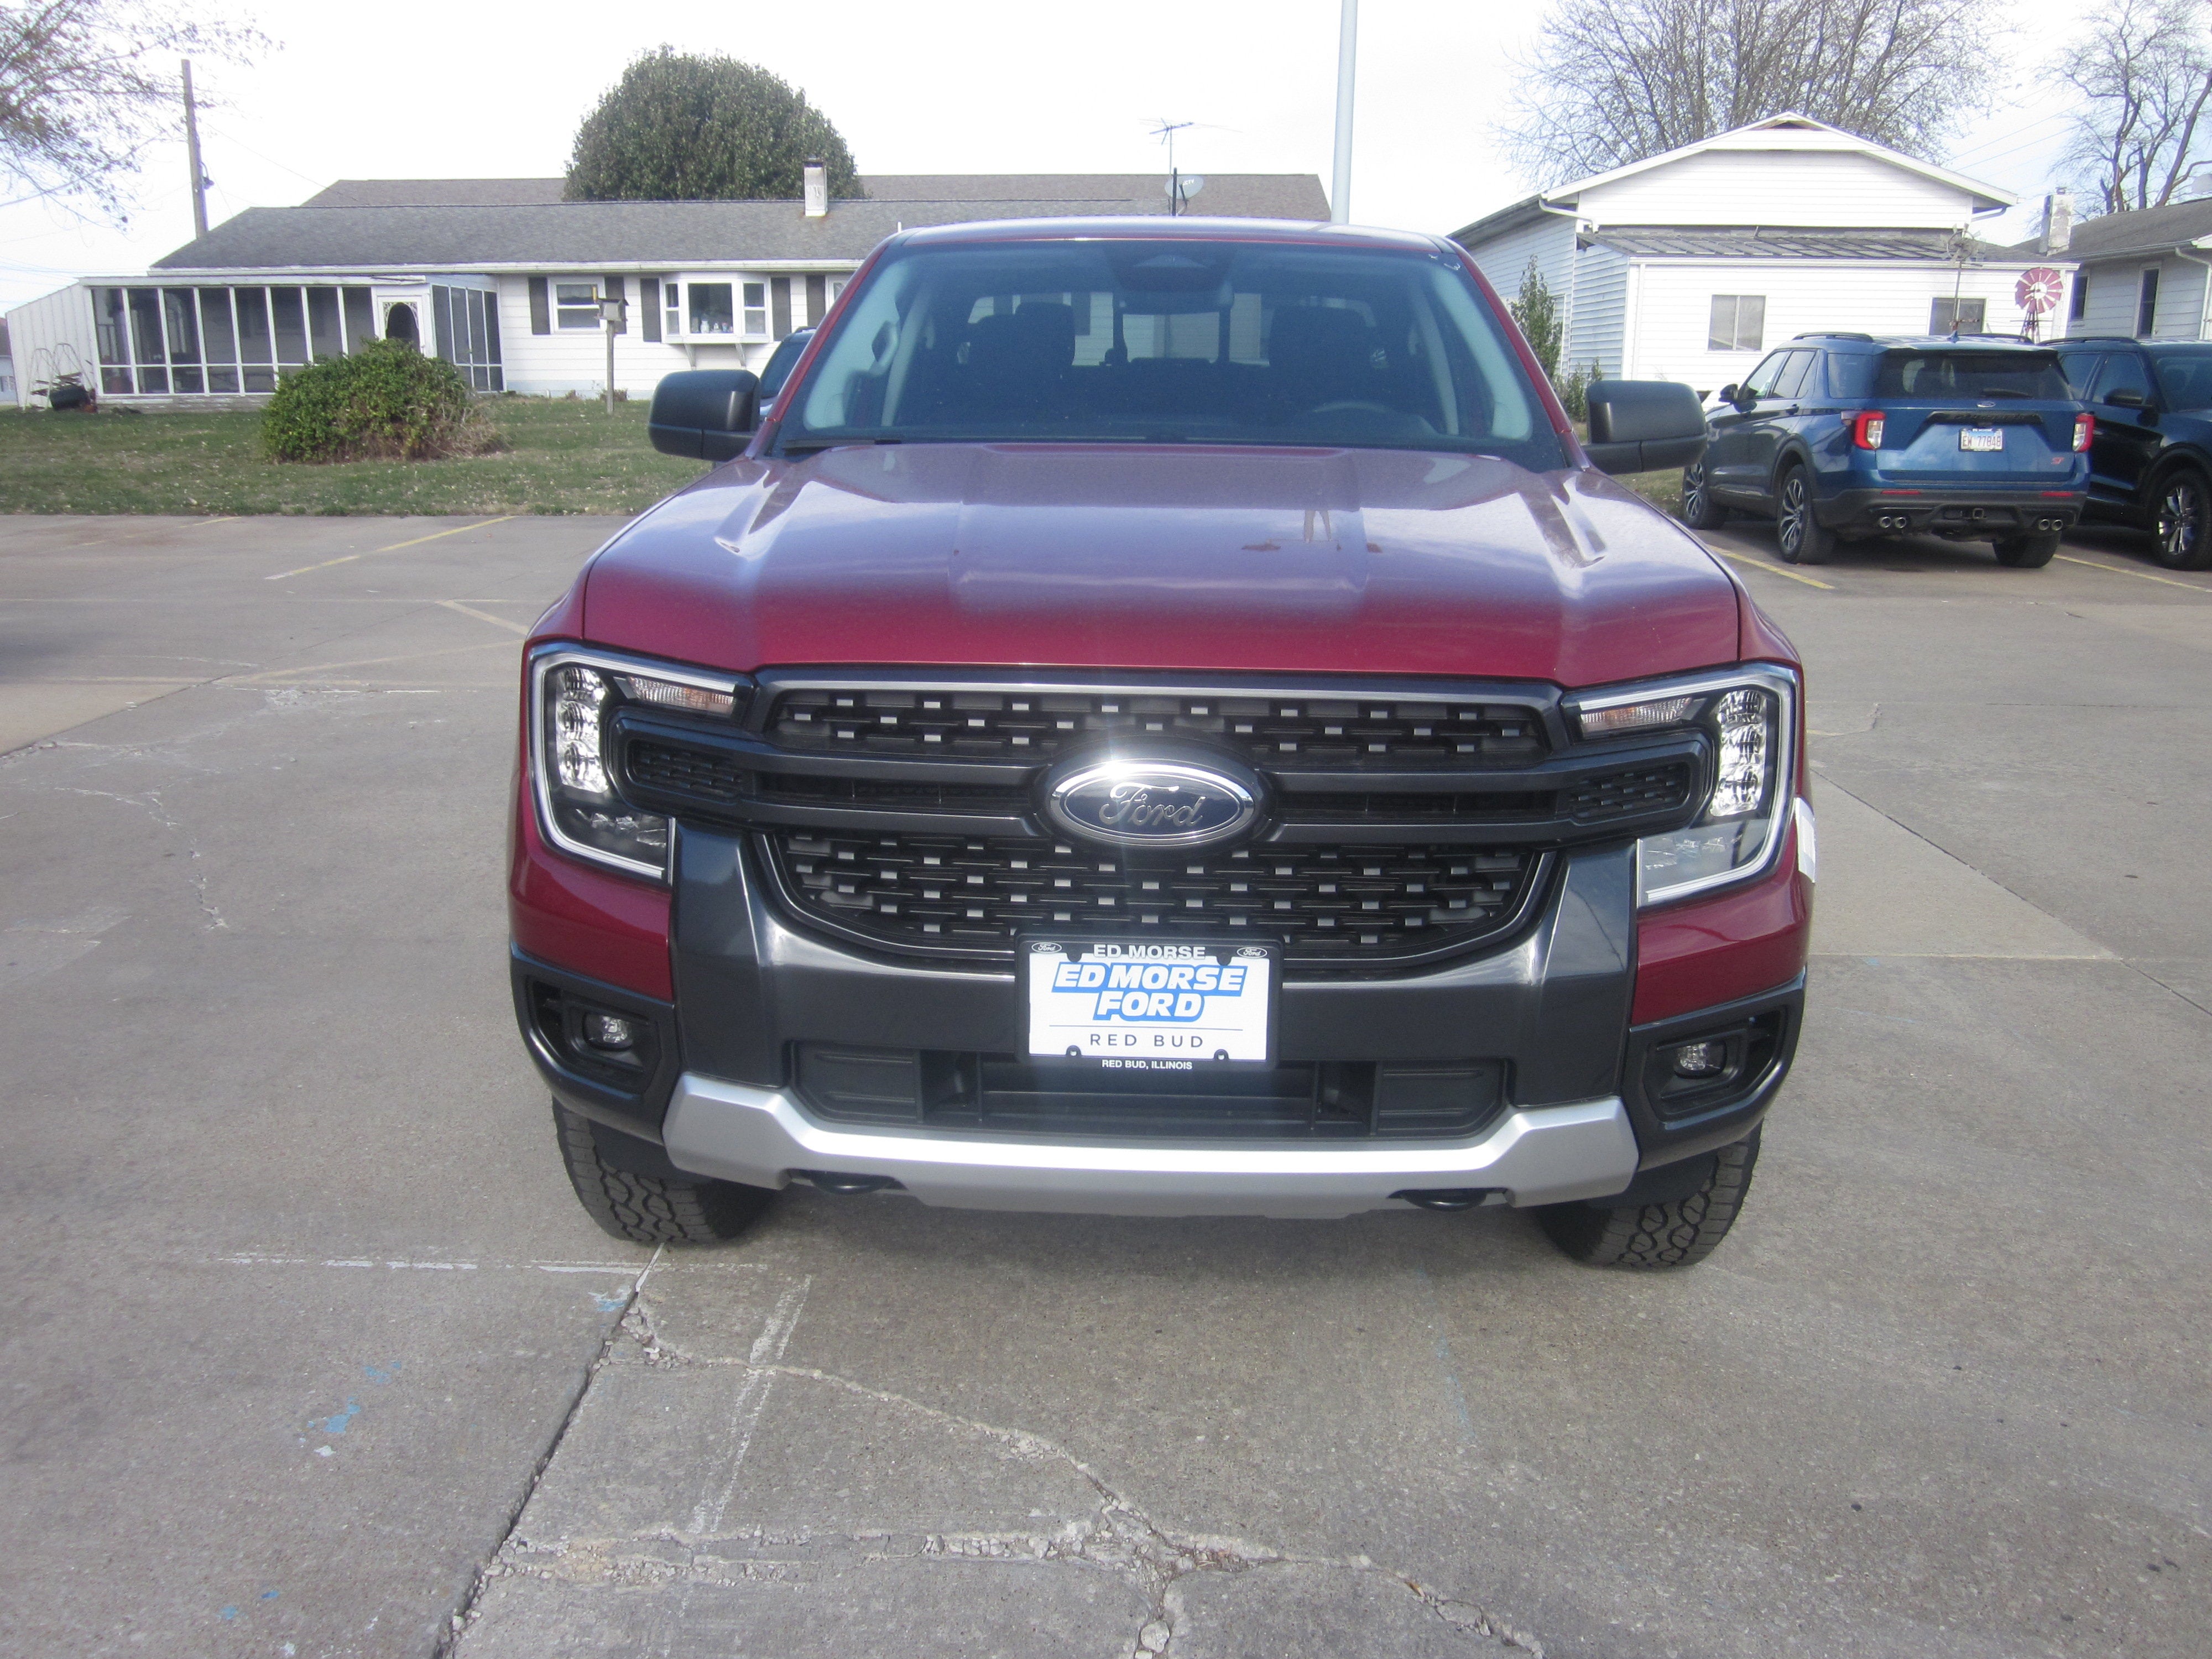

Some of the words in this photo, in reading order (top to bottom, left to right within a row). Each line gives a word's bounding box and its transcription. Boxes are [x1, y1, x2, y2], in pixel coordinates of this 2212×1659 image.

[1978, 435, 2001, 447] 77848
[1098, 781, 1206, 827] Ford
[1093, 943, 1122, 958] ED
[1128, 944, 1206, 960] MORSE
[1054, 964, 1105, 988] ED
[1107, 964, 1245, 991] MORSE
[1096, 990, 1203, 1017] FORD
[1090, 1033, 1138, 1046] RED
[1154, 1035, 1203, 1048] BUD
[1102, 1059, 1123, 1068] RED
[1125, 1060, 1149, 1070] BUD,
[1151, 1061, 1193, 1070] ILLINOIS
